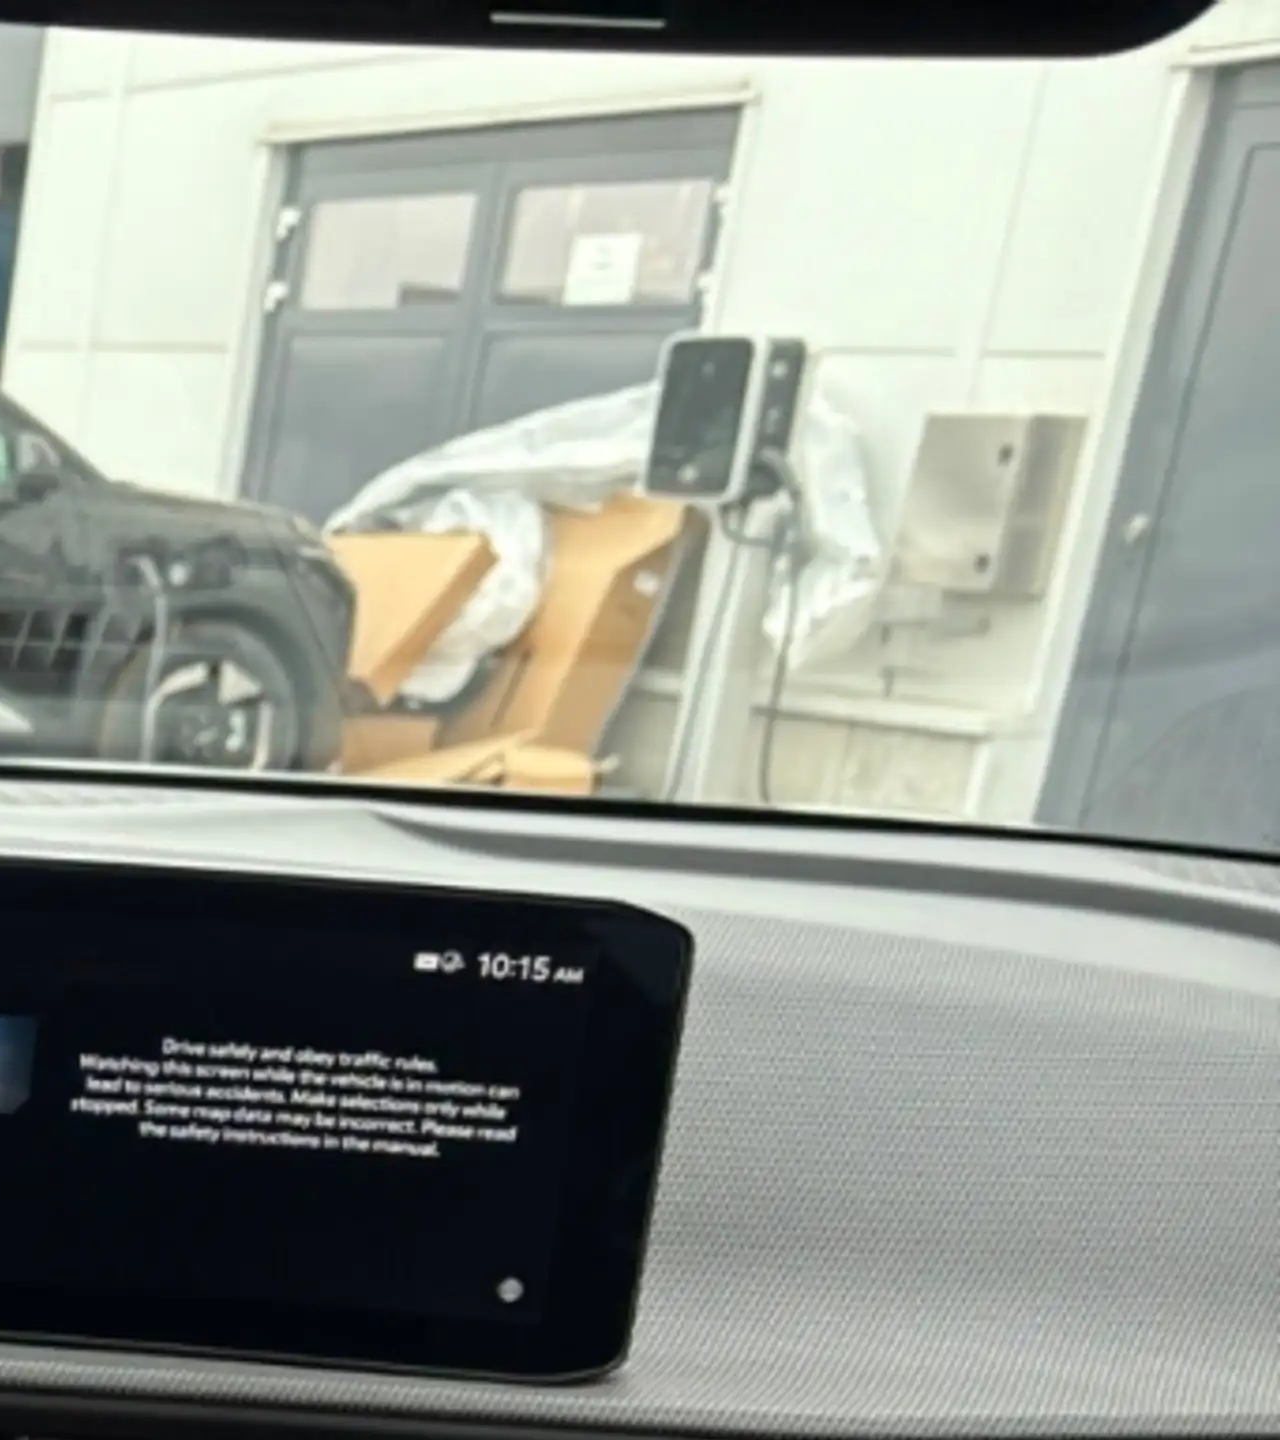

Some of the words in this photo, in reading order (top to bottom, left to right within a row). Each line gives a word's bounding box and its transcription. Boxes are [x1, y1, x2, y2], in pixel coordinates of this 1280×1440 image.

[477, 951, 552, 983] 10:15
[552, 966, 585, 984] AM
[162, 1036, 205, 1056] Drive
[208, 1042, 258, 1063] safely
[260, 1046, 293, 1063] and
[295, 1047, 335, 1069] obey
[338, 1051, 390, 1070] traffic
[394, 1055, 437, 1073] rules.
[79, 1053, 160, 1078] Watching
[162, 1059, 193, 1076] this
[196, 1063, 250, 1079] screen
[252, 1067, 296, 1084] while
[299, 1070, 326, 1085] the
[329, 1073, 387, 1090] vehicle
[389, 1076, 404, 1091] is
[405, 1078, 423, 1092] in
[425, 1079, 486, 1097] motion
[488, 1086, 521, 1099] can
[86, 1074, 123, 1093] lead
[124, 1080, 142, 1094] to
[144, 1081, 202, 1098] serious
[291, 1089, 336, 1107] Make
[339, 1093, 420, 1113] selections
[424, 1100, 461, 1119] only
[462, 1103, 507, 1121] while
[139, 1120, 167, 1138] the
[169, 1123, 221, 1144] safety
[222, 1127, 321, 1149] instructions
[342, 1135, 370, 1151] the
[372, 1140, 440, 1158] manual.
[144, 1099, 190, 1117] Some
[193, 1106, 232, 1123] map
[234, 1107, 273, 1124] data
[275, 1111, 310, 1130] may
[314, 1110, 336, 1128] be
[421, 1117, 475, 1138] Please
[477, 1126, 518, 1142] read
